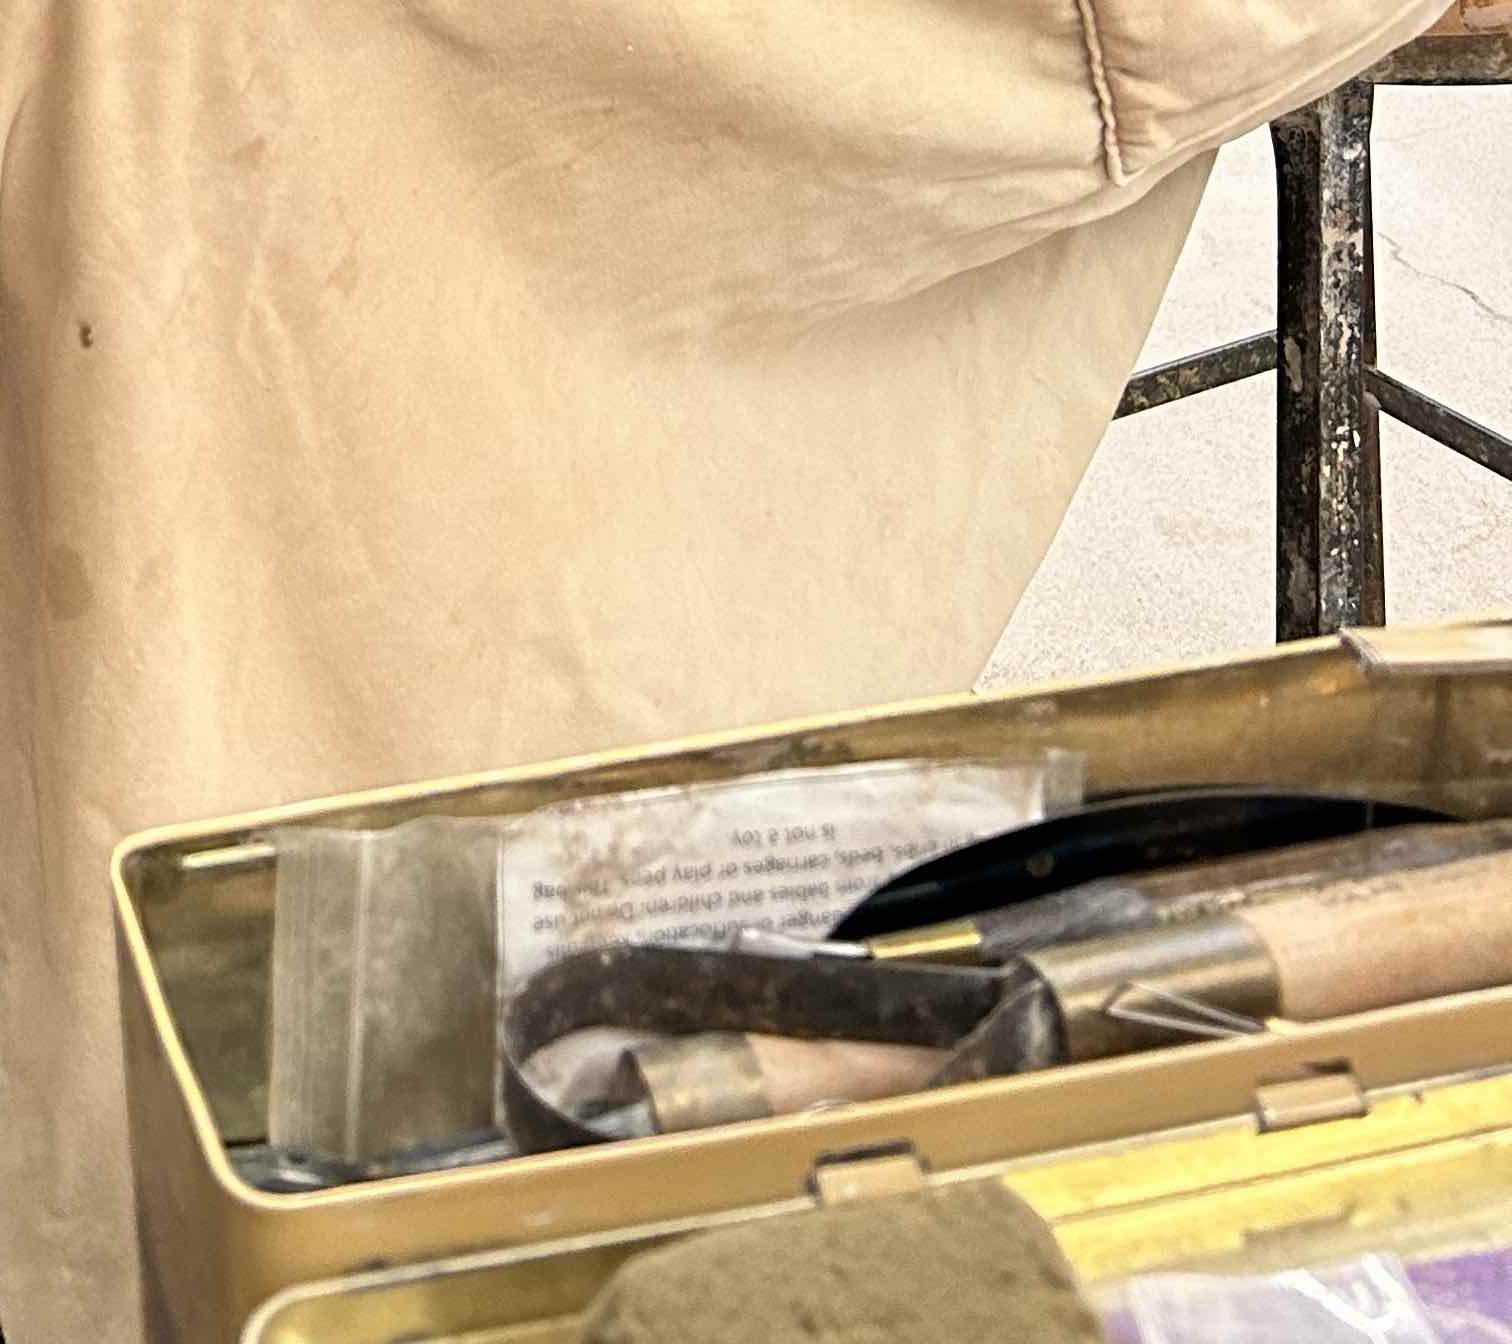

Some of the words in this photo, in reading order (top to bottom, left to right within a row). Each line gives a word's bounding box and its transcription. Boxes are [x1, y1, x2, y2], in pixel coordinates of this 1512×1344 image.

[767, 826, 780, 848] a
[784, 825, 819, 847] not
[821, 823, 836, 842] is
[671, 862, 713, 883] play
[718, 862, 738, 879] or
[742, 853, 832, 875] carriages
[729, 889, 766, 908] and
